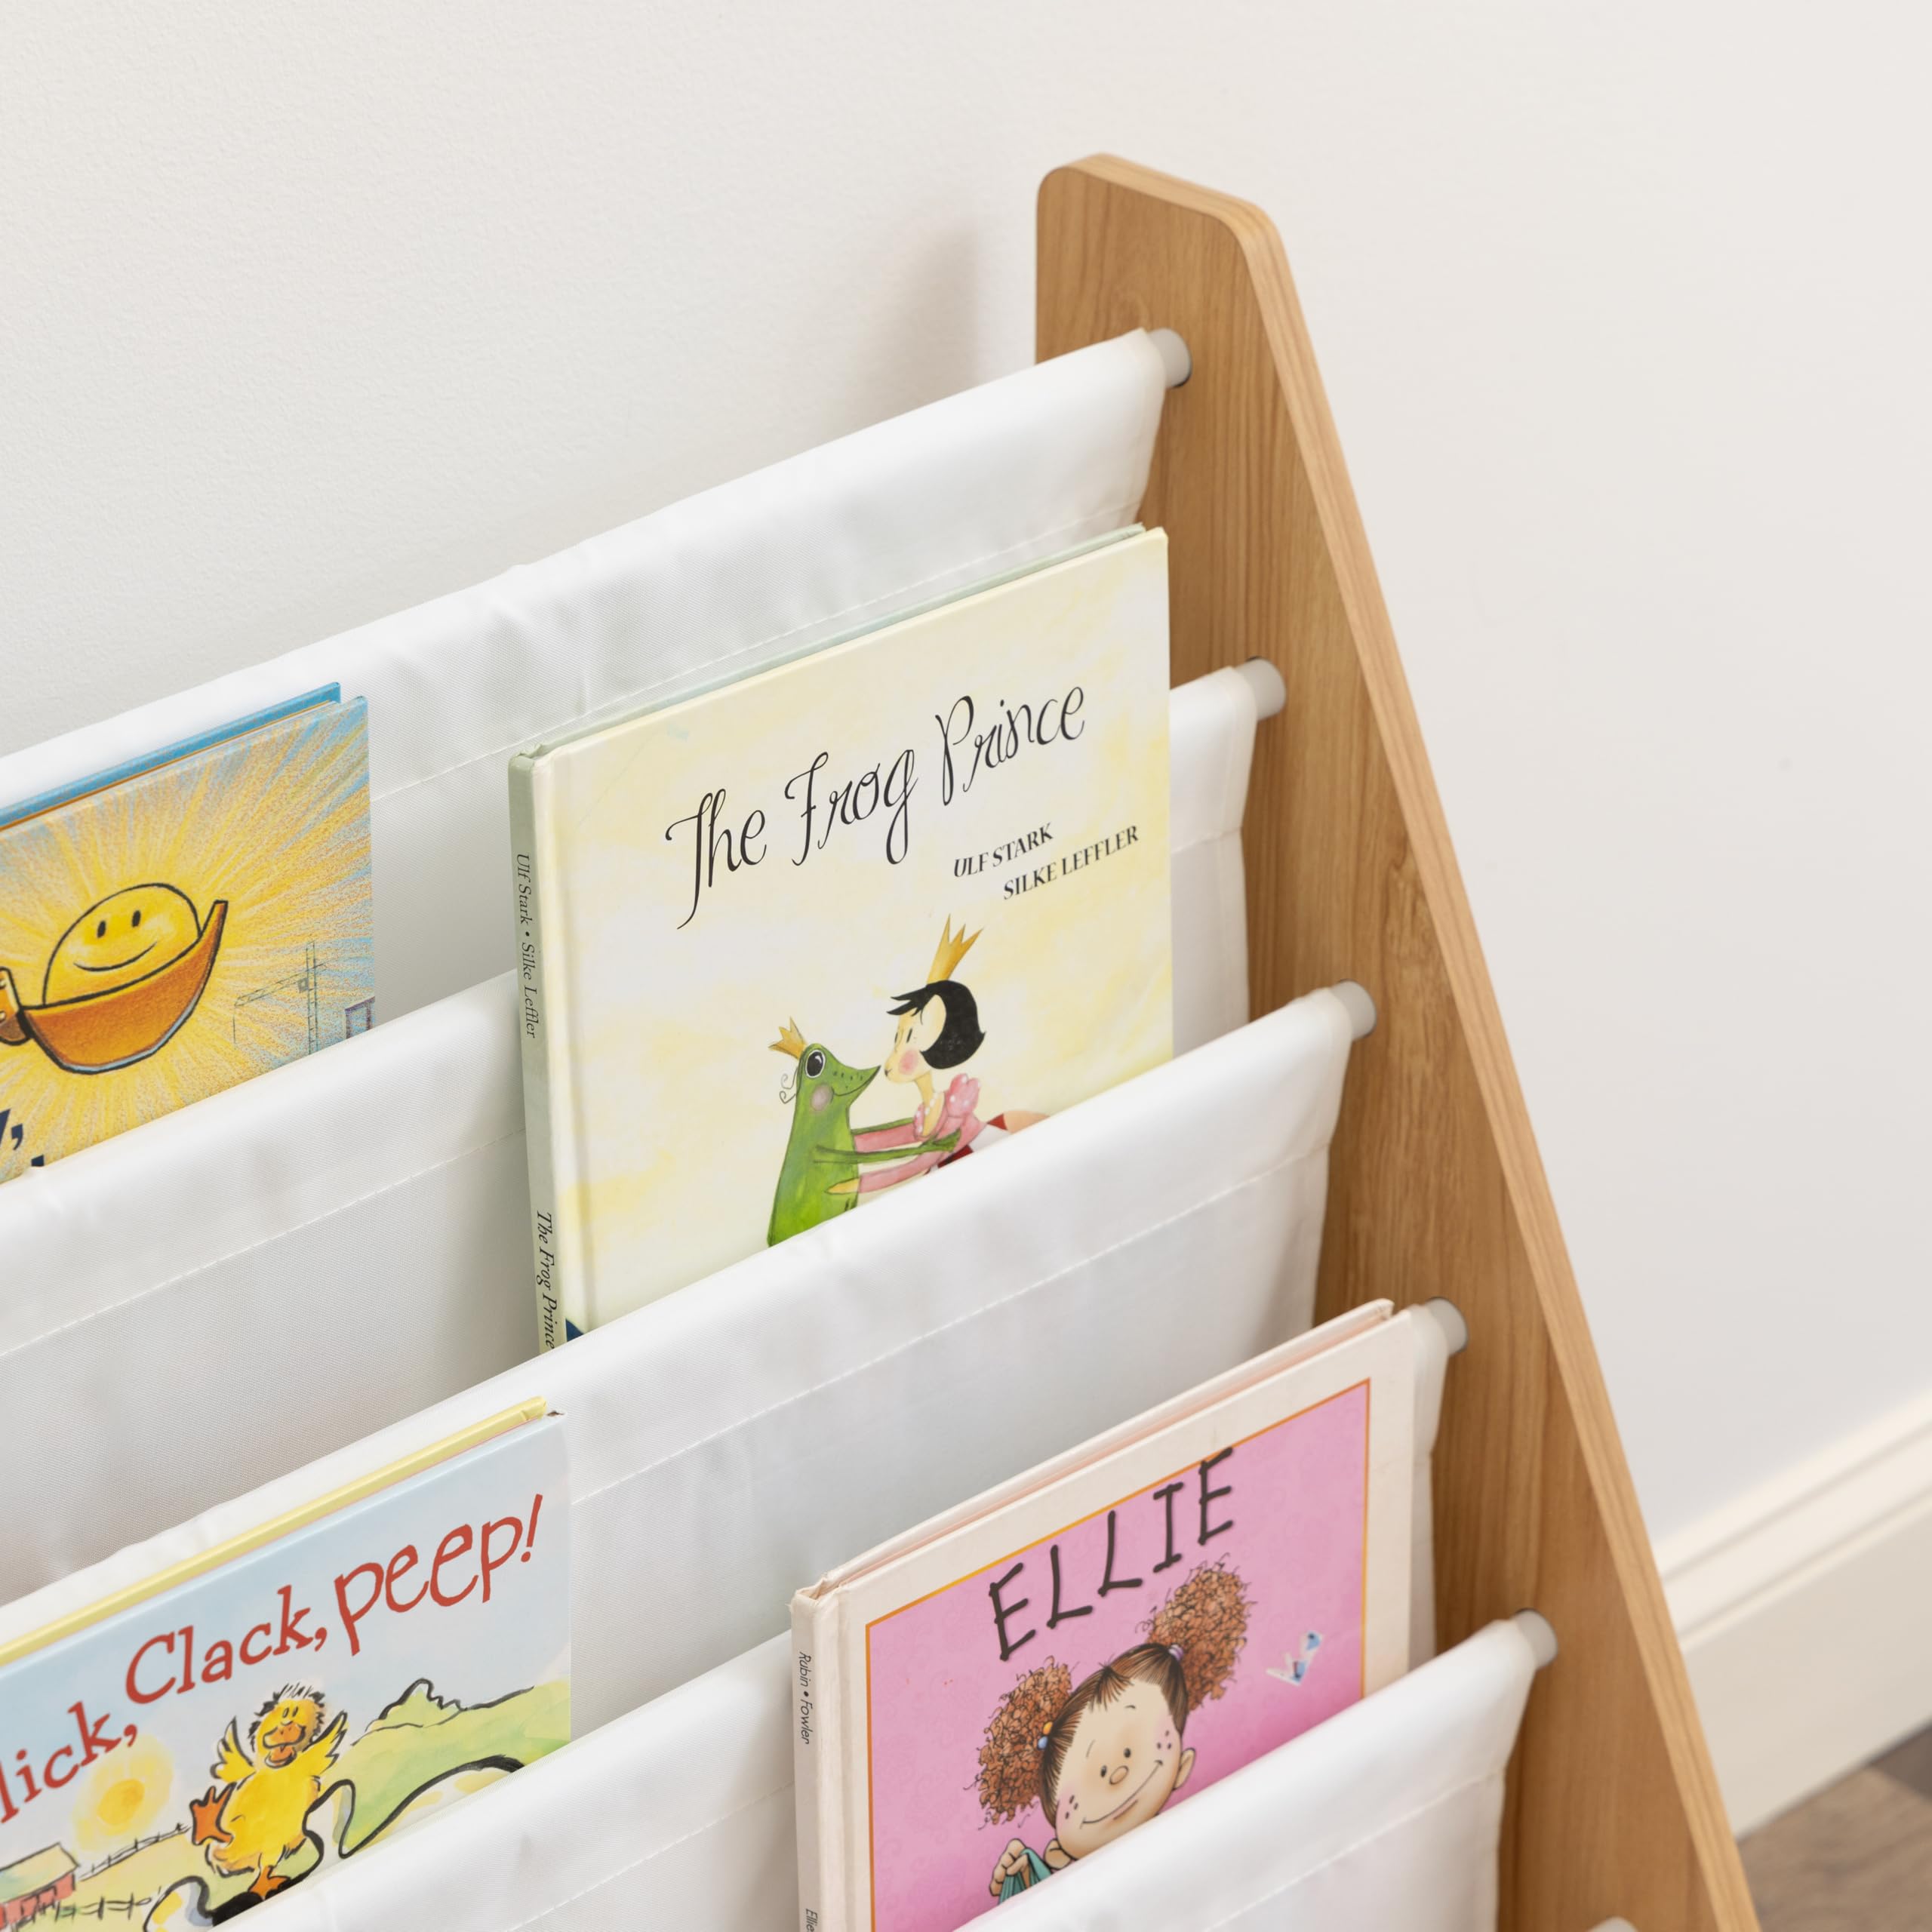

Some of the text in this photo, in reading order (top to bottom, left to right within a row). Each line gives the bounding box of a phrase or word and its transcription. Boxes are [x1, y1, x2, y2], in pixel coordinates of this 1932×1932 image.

[665, 686, 1085, 929] The Frog Prince
[953, 822, 1054, 878] ULF STARK
[1003, 825, 1140, 900] SILKE LEFFLER
[516, 853, 540, 1039] Ulf Stark Silke Leffler
[536, 1210, 558, 1349] The Frog Prince
[124, 1584, 328, 1706] Clack,
[333, 1494, 544, 1657] peep!
[989, 1446, 1235, 1662] ELLIE
[798, 1651, 814, 1745] Rubin Fowler
